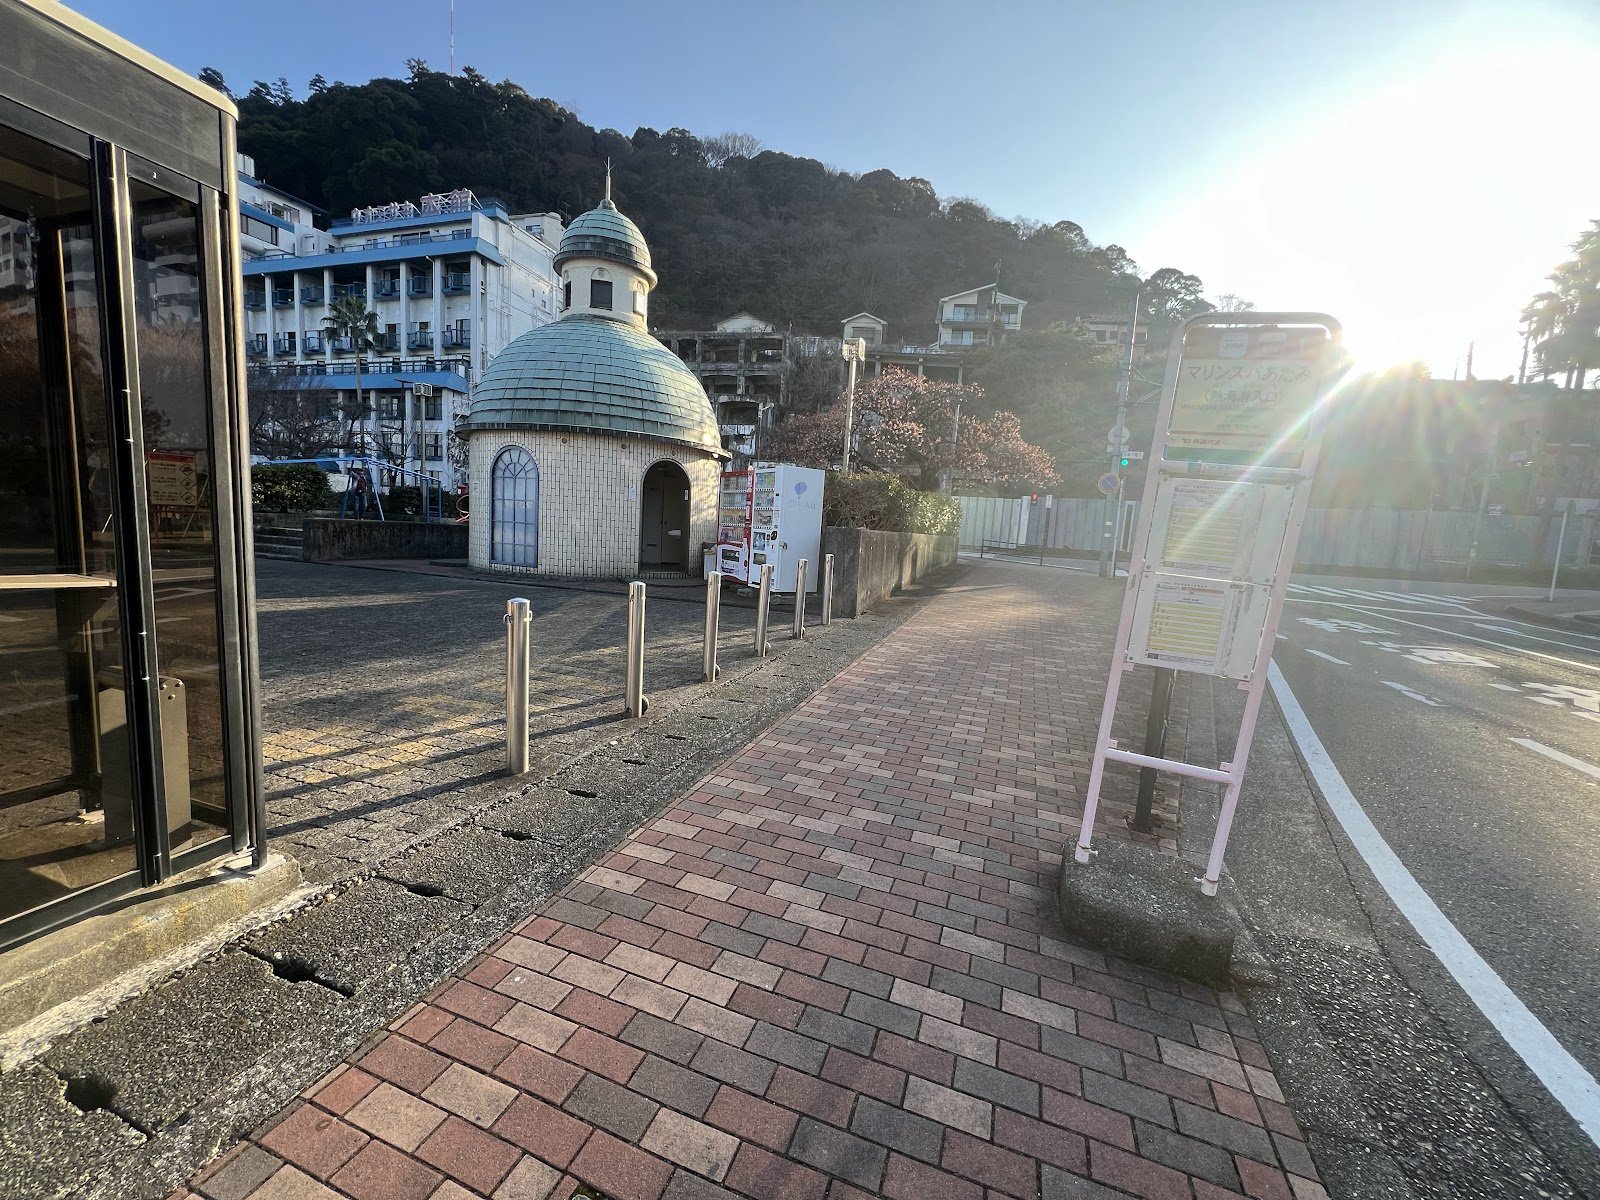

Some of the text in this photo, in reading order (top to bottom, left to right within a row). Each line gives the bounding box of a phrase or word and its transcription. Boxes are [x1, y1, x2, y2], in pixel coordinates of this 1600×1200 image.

[1187, 365, 1311, 384] マリンスパあたみ
